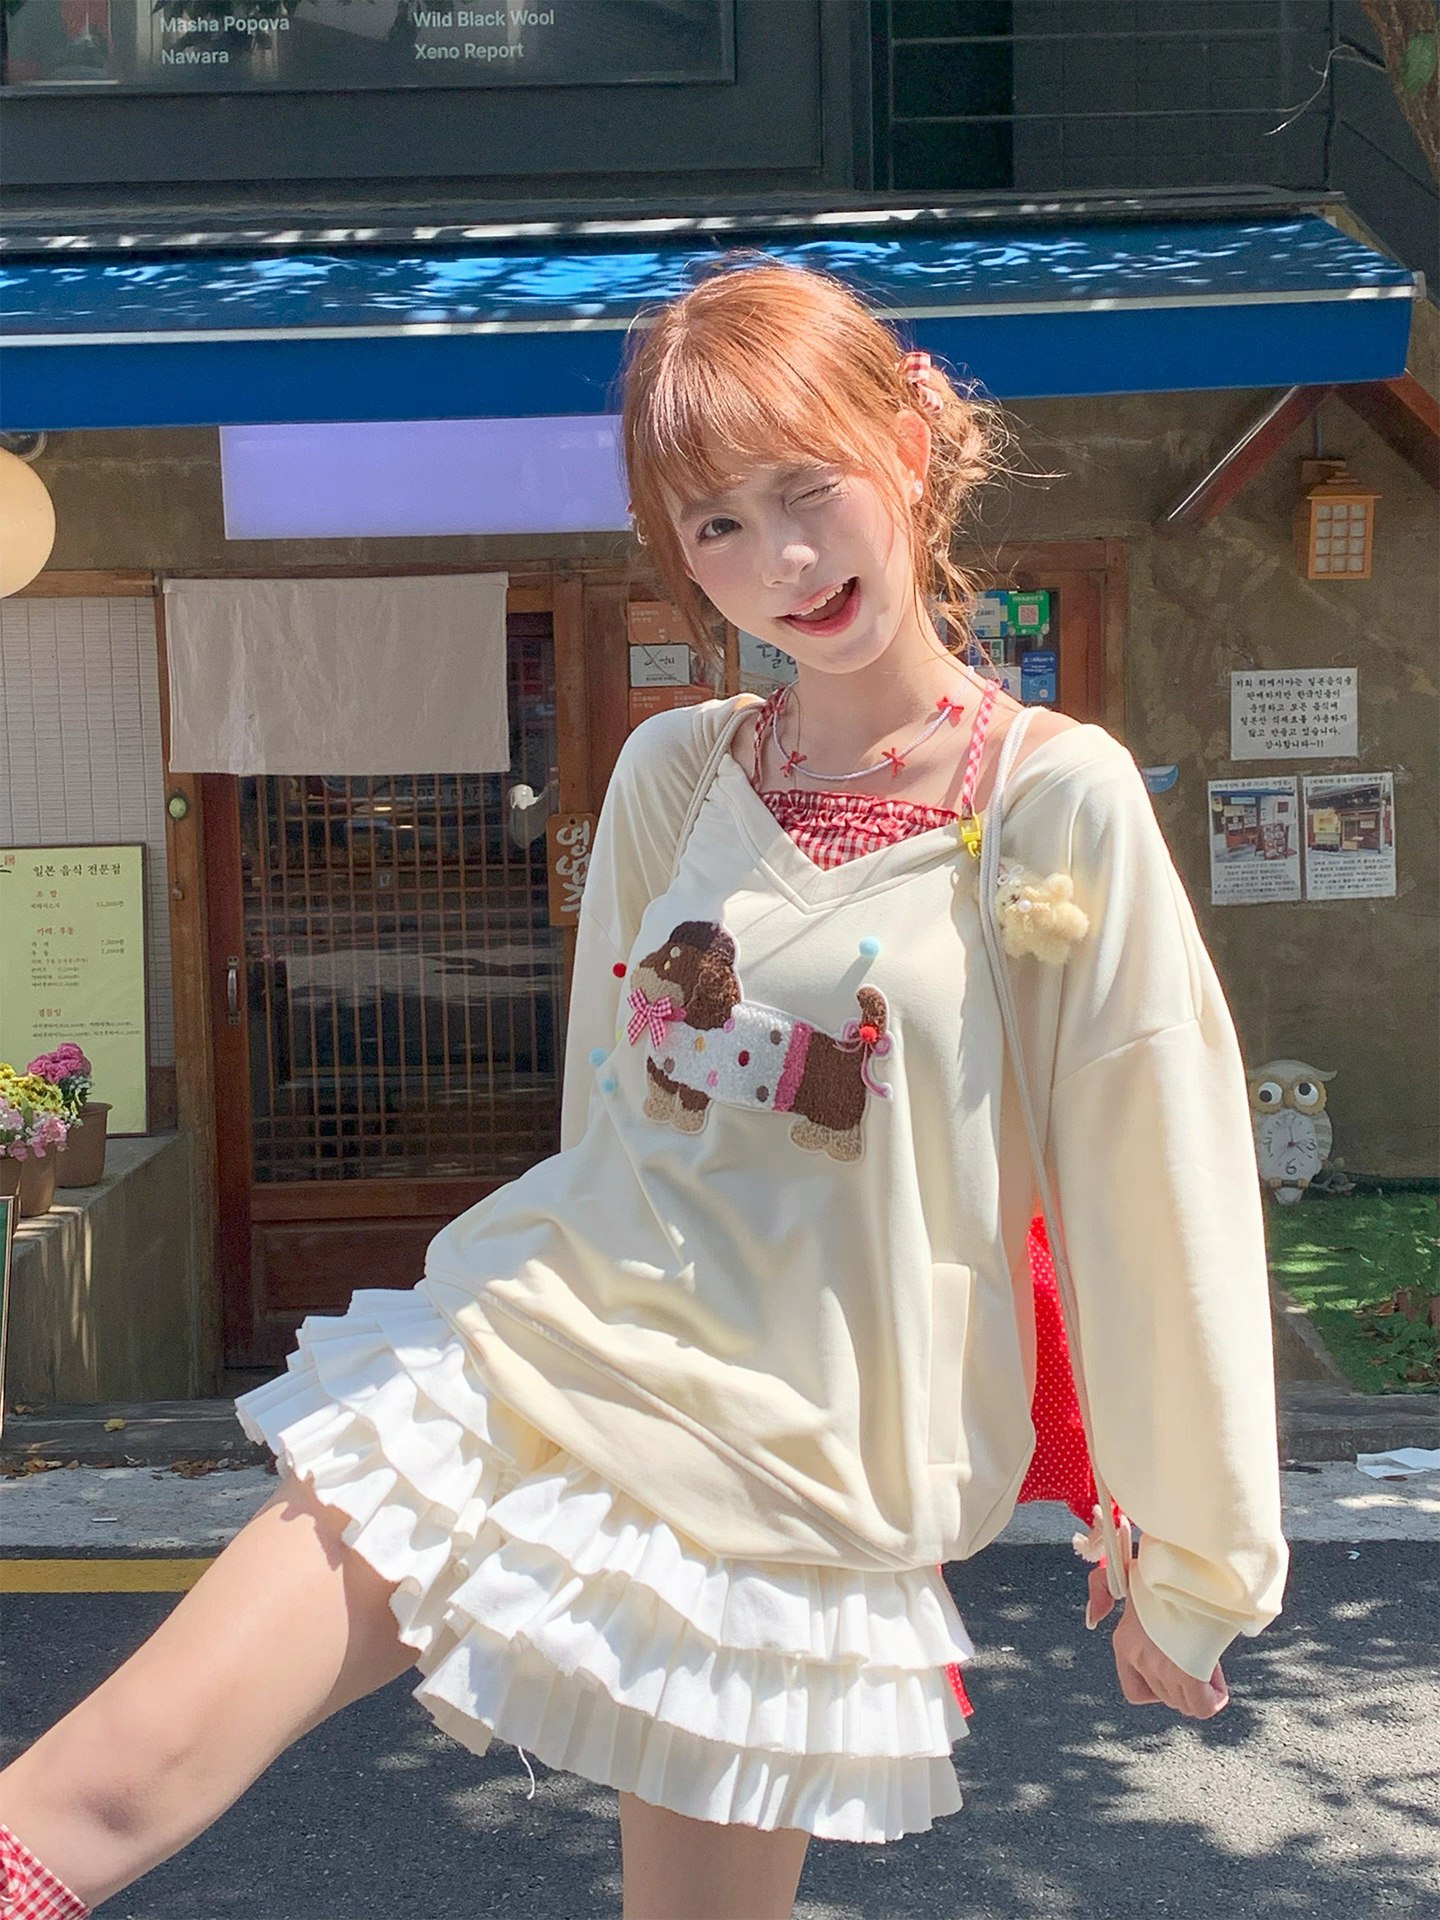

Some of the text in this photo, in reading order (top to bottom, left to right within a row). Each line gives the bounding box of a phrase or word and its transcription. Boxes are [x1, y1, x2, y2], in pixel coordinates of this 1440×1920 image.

[159, 15, 291, 35] Masha Popova
[413, 9, 555, 27] Wild Black Wool
[161, 49, 230, 64] Nawara
[414, 43, 524, 62] Xeno Report
[1308, 676, 1352, 687] 일본음식을
[1247, 690, 1292, 701] 판매하지만
[1250, 701, 1338, 713] 운영하고 모든 음식에
[1240, 715, 1267, 726] 일본산
[1313, 714, 1347, 724] 사용하지
[1271, 727, 1297, 737] 만들고
[33, 863, 121, 877] 일본 음식 전문점
[1285, 1157, 1297, 1175] 6
